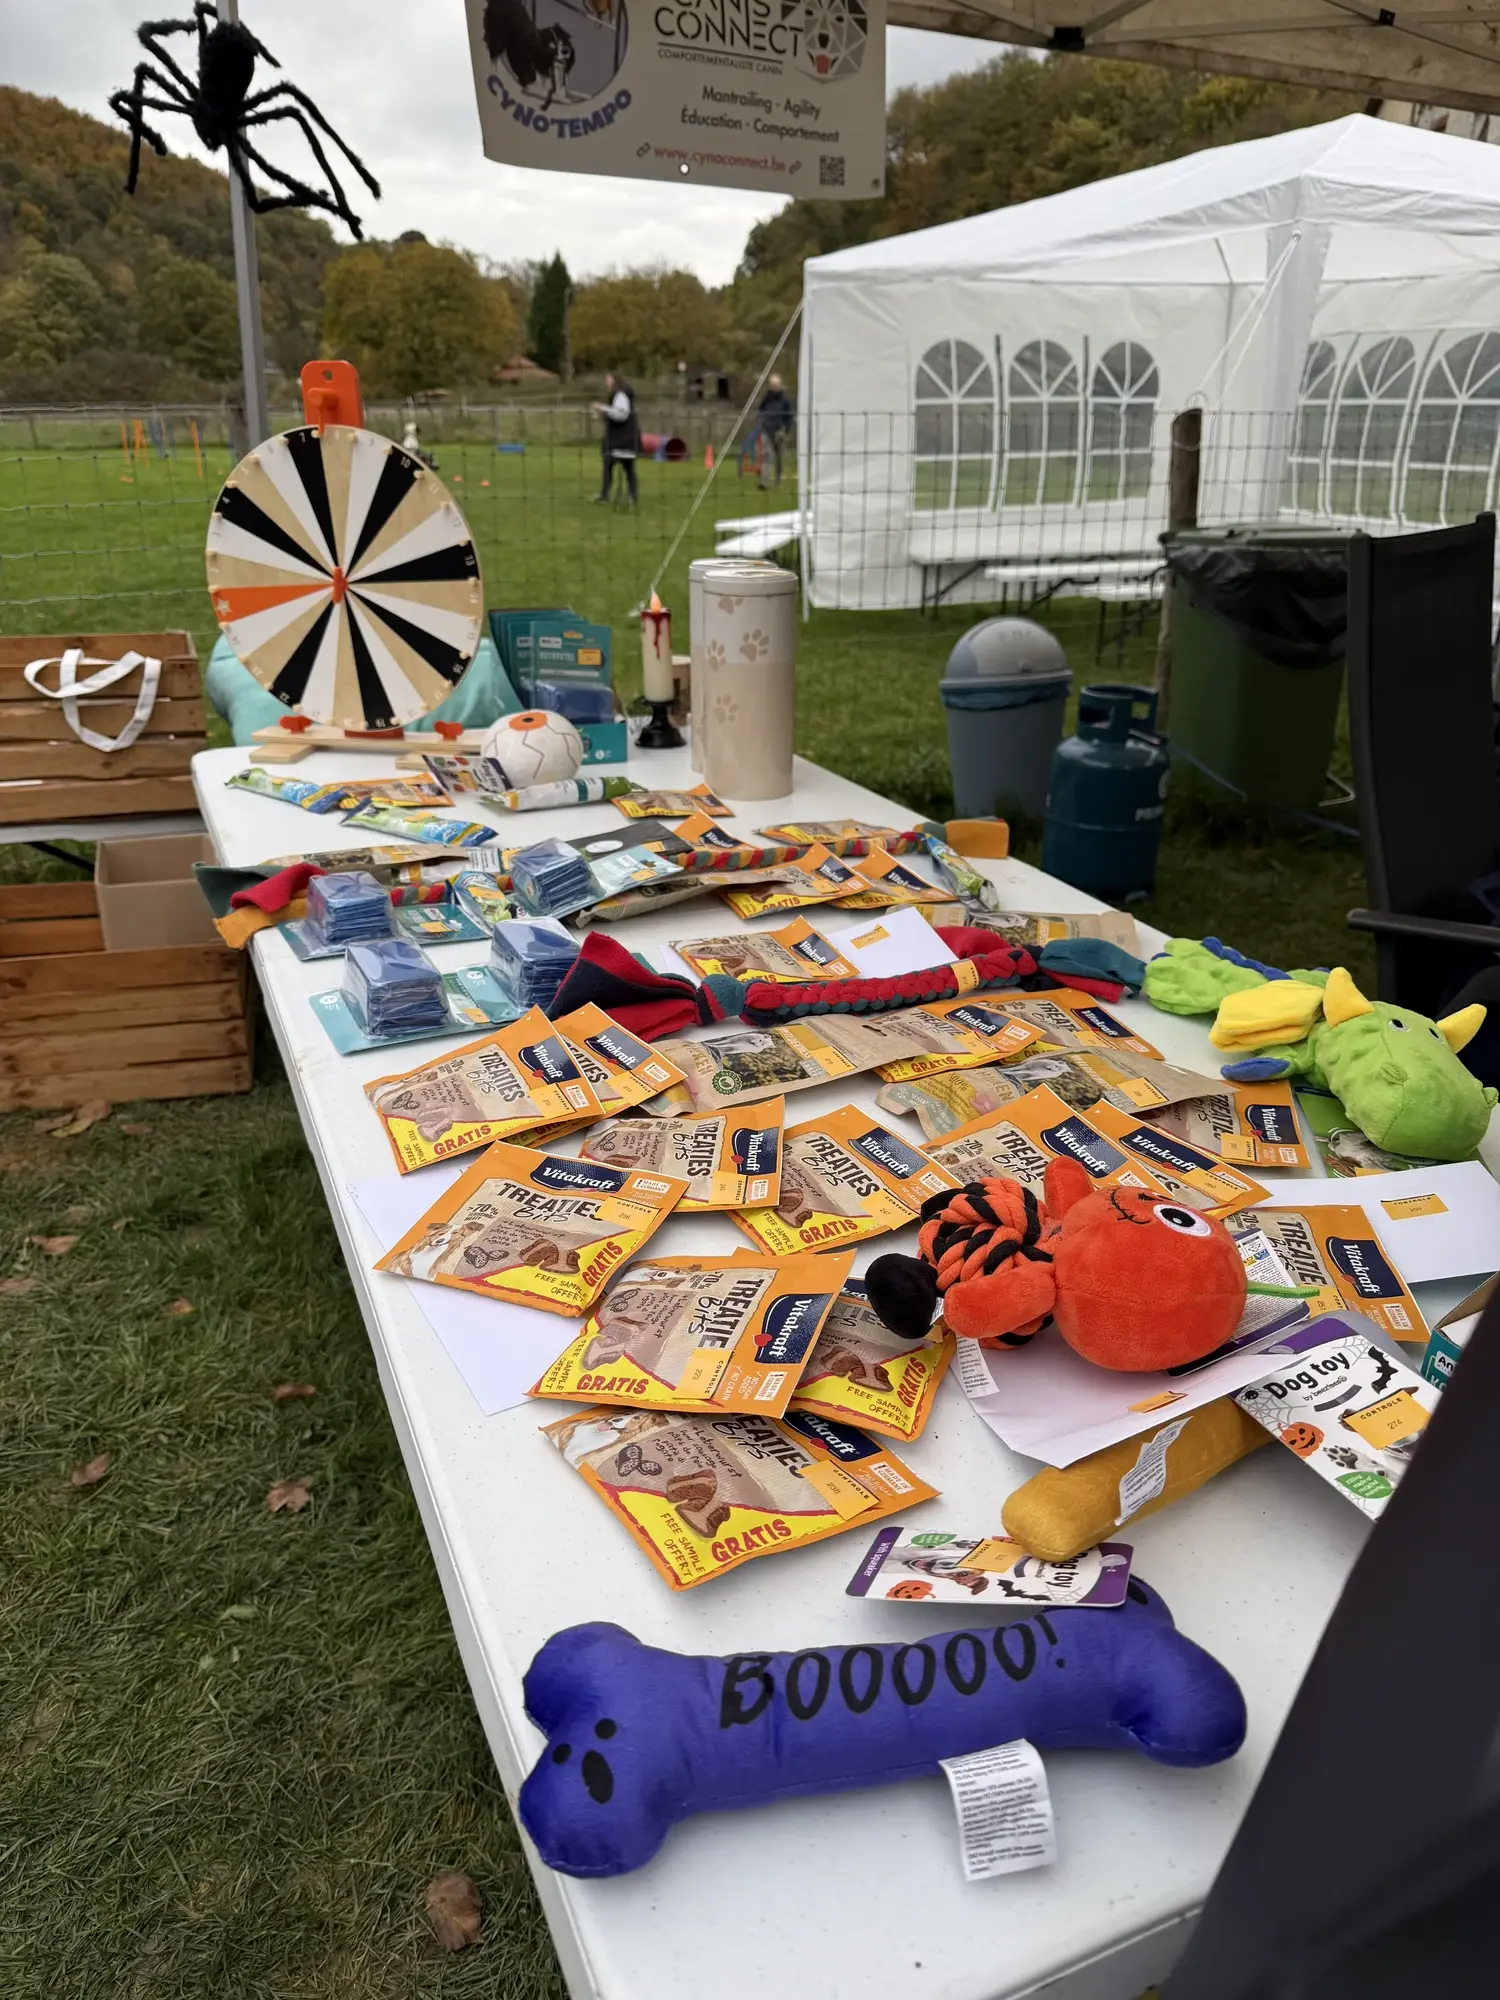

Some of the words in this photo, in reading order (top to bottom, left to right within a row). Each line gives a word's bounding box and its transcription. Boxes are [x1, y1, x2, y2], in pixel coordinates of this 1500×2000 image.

[655, 6, 804, 57] CONNECT
[755, 62, 783, 76] CANIN
[487, 73, 632, 139] CYNOTEMPO
[702, 85, 773, 114] Mantrailing
[783, 97, 822, 121] Agility
[681, 105, 743, 131] Éducation
[753, 117, 840, 143] Comportement
[654, 147, 786, 172] www.cynoconnect.be
[798, 939, 828, 966] Vitakraft
[911, 1010, 967, 1037] TREATIE
[955, 1008, 998, 1034] Vitakraft
[1081, 1009, 1119, 1037] Vitakraft
[532, 1044, 564, 1079] Vitakraft
[566, 1040, 609, 1084] EATIES
[597, 1034, 636, 1067] Vitakraft
[911, 1056, 958, 1074] GRATIS
[478, 1052, 525, 1103] TREATIES
[434, 1125, 492, 1156] GRATIS
[1261, 1107, 1281, 1142] Vitakraft
[402, 1144, 418, 1167] OFFERT
[412, 1140, 428, 1164] SAMPLE
[687, 1120, 720, 1177] TREATIES
[747, 1132, 763, 1172] Vitakraft
[860, 1136, 910, 1174] Vitakraft
[995, 1130, 1050, 1182] TREAT
[1055, 1126, 1109, 1172] Vitakraft
[1130, 1134, 1198, 1171] Vitakraft
[542, 1166, 617, 1190] Vitakraft
[805, 1135, 881, 1198] TREATIES
[616, 1201, 652, 1213] CONTROLE
[885, 1196, 913, 1216] CONTROLE
[762, 1212, 778, 1229] FREE
[774, 1226, 795, 1251] SAMPLE
[764, 1229, 786, 1253] OFFERT
[799, 1219, 859, 1244] GRATIS
[581, 1241, 623, 1288] GRATIS
[1276, 1220, 1329, 1286] TREATIE
[1343, 1243, 1381, 1294] Vitakraft
[534, 1272, 556, 1286] FREE
[559, 1280, 589, 1299] SAMPLE
[550, 1286, 586, 1303] OFFERT
[698, 1278, 766, 1350] TREATIE
[769, 1298, 812, 1358] Vitakraft
[545, 1357, 567, 1390] OFFERT
[556, 1360, 574, 1390] SAMPLE
[576, 1373, 649, 1395] GRATIS
[704, 1359, 724, 1394] CONTROLE
[896, 1356, 928, 1408] GRATIS
[1263, 1369, 1319, 1400] Dog
[1311, 1351, 1351, 1376] toy
[846, 1386, 873, 1400] FREE
[875, 1398, 912, 1422] SAMPLE
[1302, 1393, 1314, 1402] by
[1359, 1396, 1404, 1420] CONTROLE
[868, 1403, 909, 1428] OFFERT
[1387, 1419, 1404, 1431] 274
[738, 1413, 808, 1480] EATIE
[800, 1412, 857, 1455] takraft
[827, 1482, 841, 1494] 238
[833, 1469, 871, 1500] CONTROLE
[660, 1512, 683, 1534] FREE
[678, 1536, 707, 1573] SAMPLE
[711, 1518, 792, 1562] GRATIS
[664, 1538, 694, 1578] OFFERT
[1045, 1570, 1080, 1589] toy
